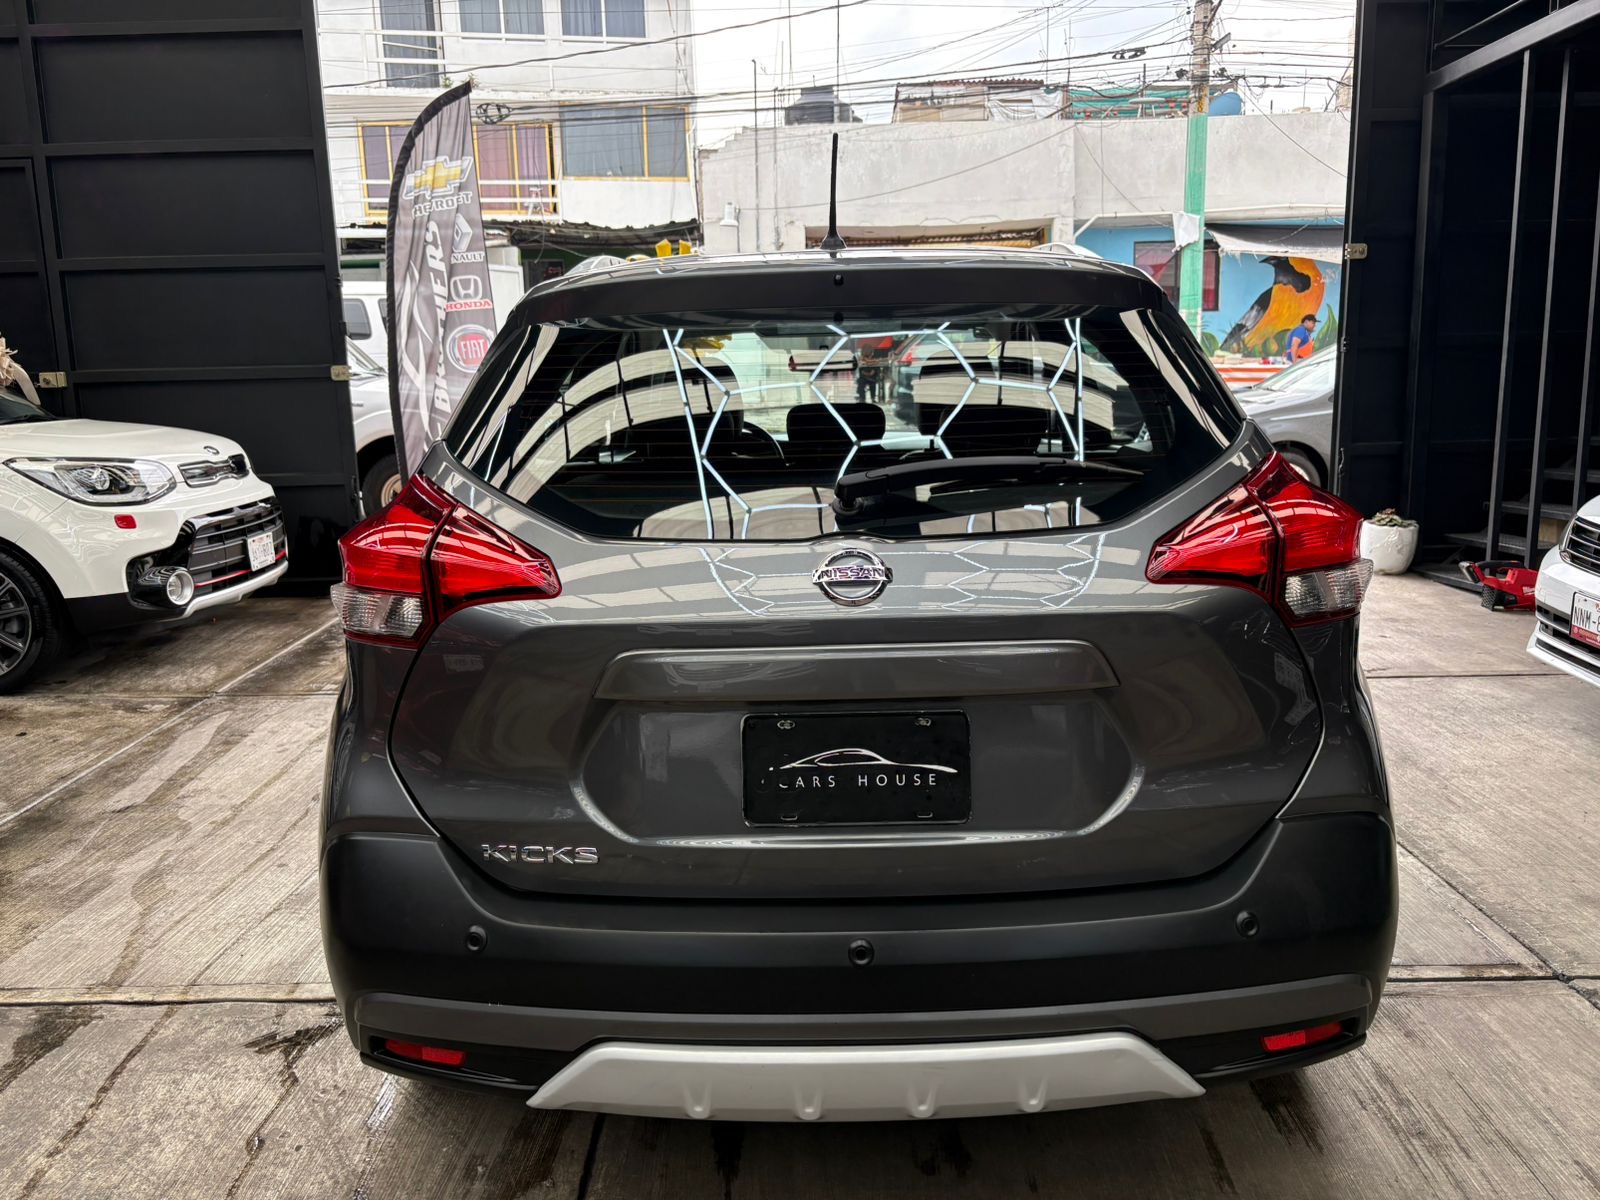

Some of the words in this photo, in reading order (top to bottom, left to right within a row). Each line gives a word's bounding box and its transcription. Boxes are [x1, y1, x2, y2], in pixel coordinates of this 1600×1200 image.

[451, 251, 485, 264] NAULT
[444, 299, 493, 312] HONDA
[460, 339, 486, 360] FIAT
[820, 567, 885, 578] NISSAN
[858, 773, 937, 787] HOUSE
[481, 844, 599, 864] KICKS
